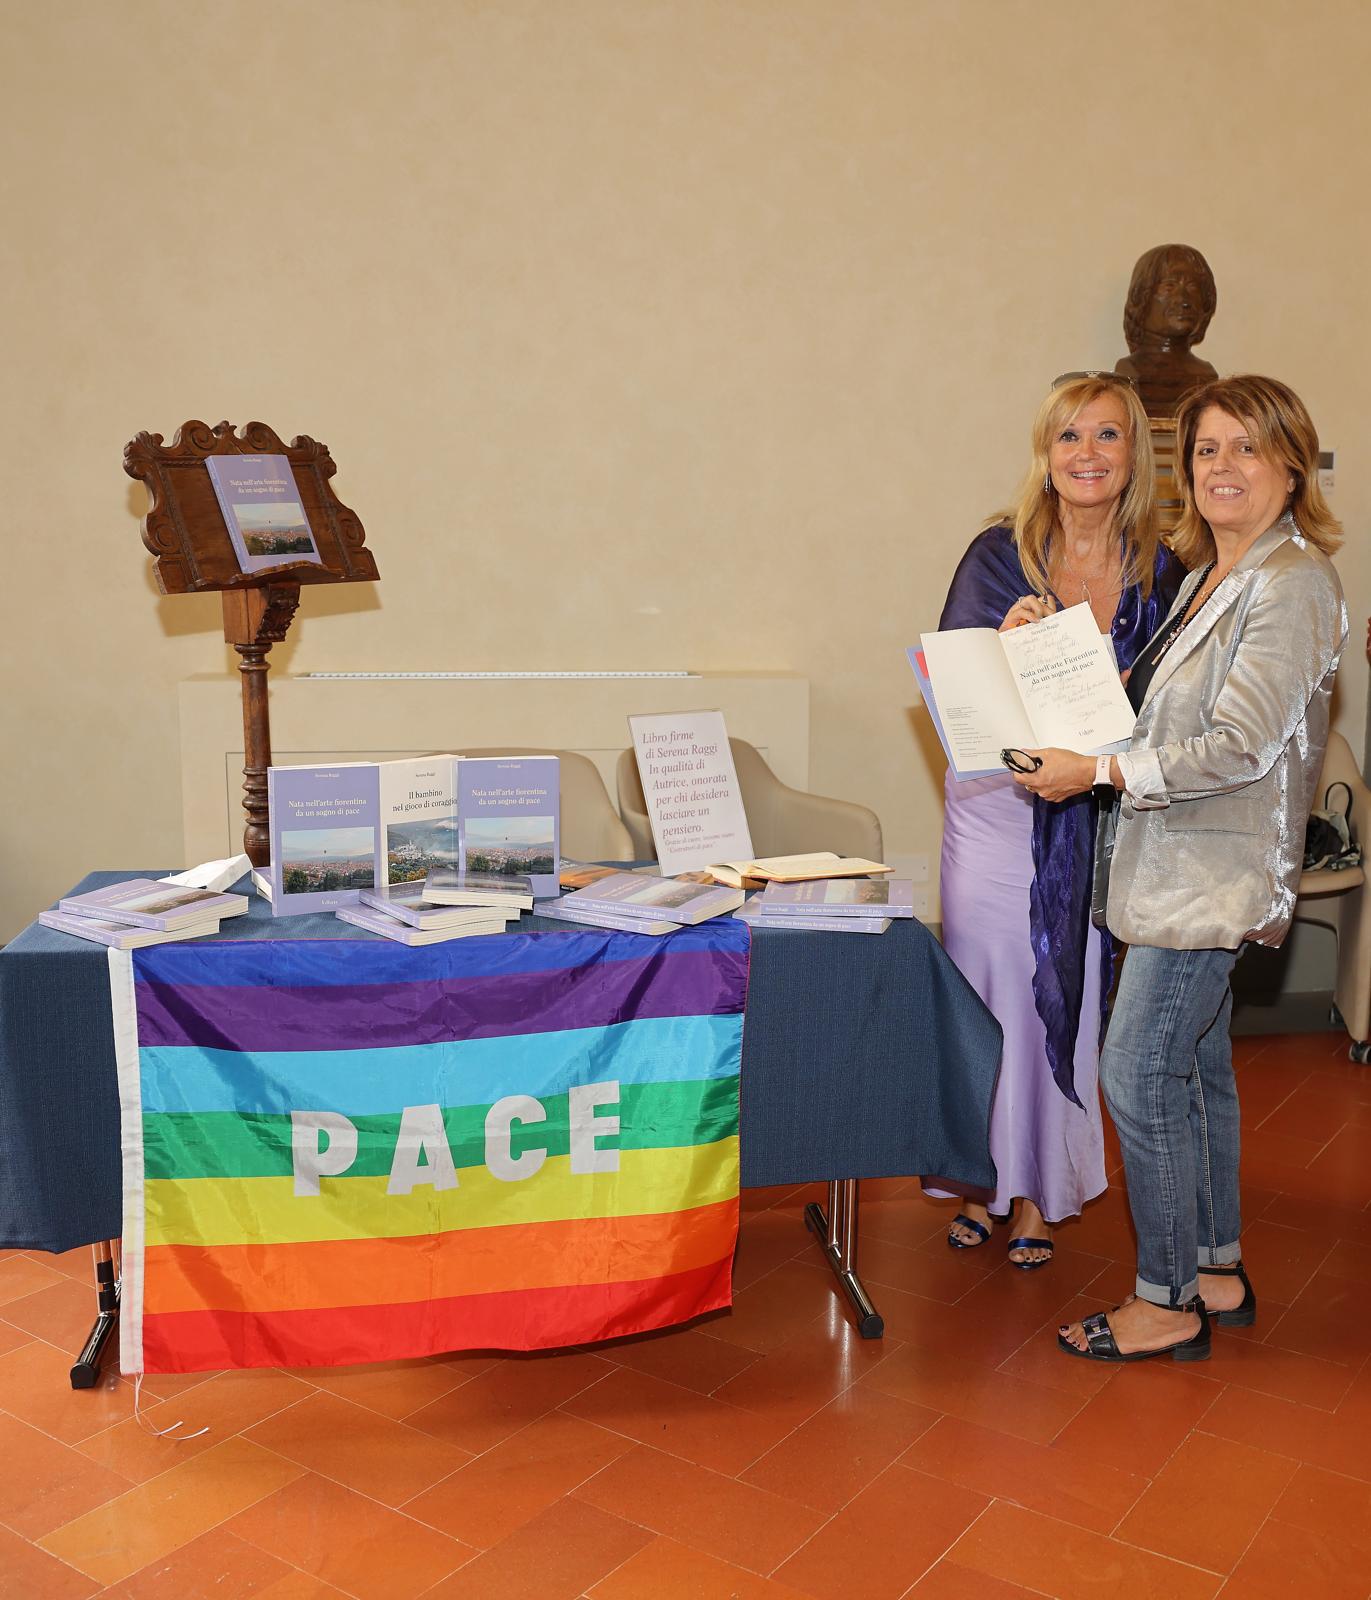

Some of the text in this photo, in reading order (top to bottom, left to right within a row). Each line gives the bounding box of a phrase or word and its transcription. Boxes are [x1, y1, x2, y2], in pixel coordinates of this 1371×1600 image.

[1019, 670, 1036, 680] Nata
[1037, 662, 1063, 674] nell'arte
[1064, 648, 1098, 665] Fiorentina
[1032, 677, 1040, 685] da
[1051, 669, 1071, 680] sogno
[1080, 661, 1094, 672] pace
[643, 731, 694, 744] Libro firme
[646, 743, 717, 759] di Serena Raggi
[649, 759, 705, 776] In qualità di
[653, 774, 727, 790] Autrice, onorata
[335, 798, 367, 806] fiorentina
[416, 790, 442, 798] bambino
[656, 789, 729, 808] per chi desidera
[405, 803, 422, 811] gioco
[660, 810, 695, 821] lasciare
[663, 824, 704, 839] pensiero.
[291, 1080, 620, 1197] PACE
